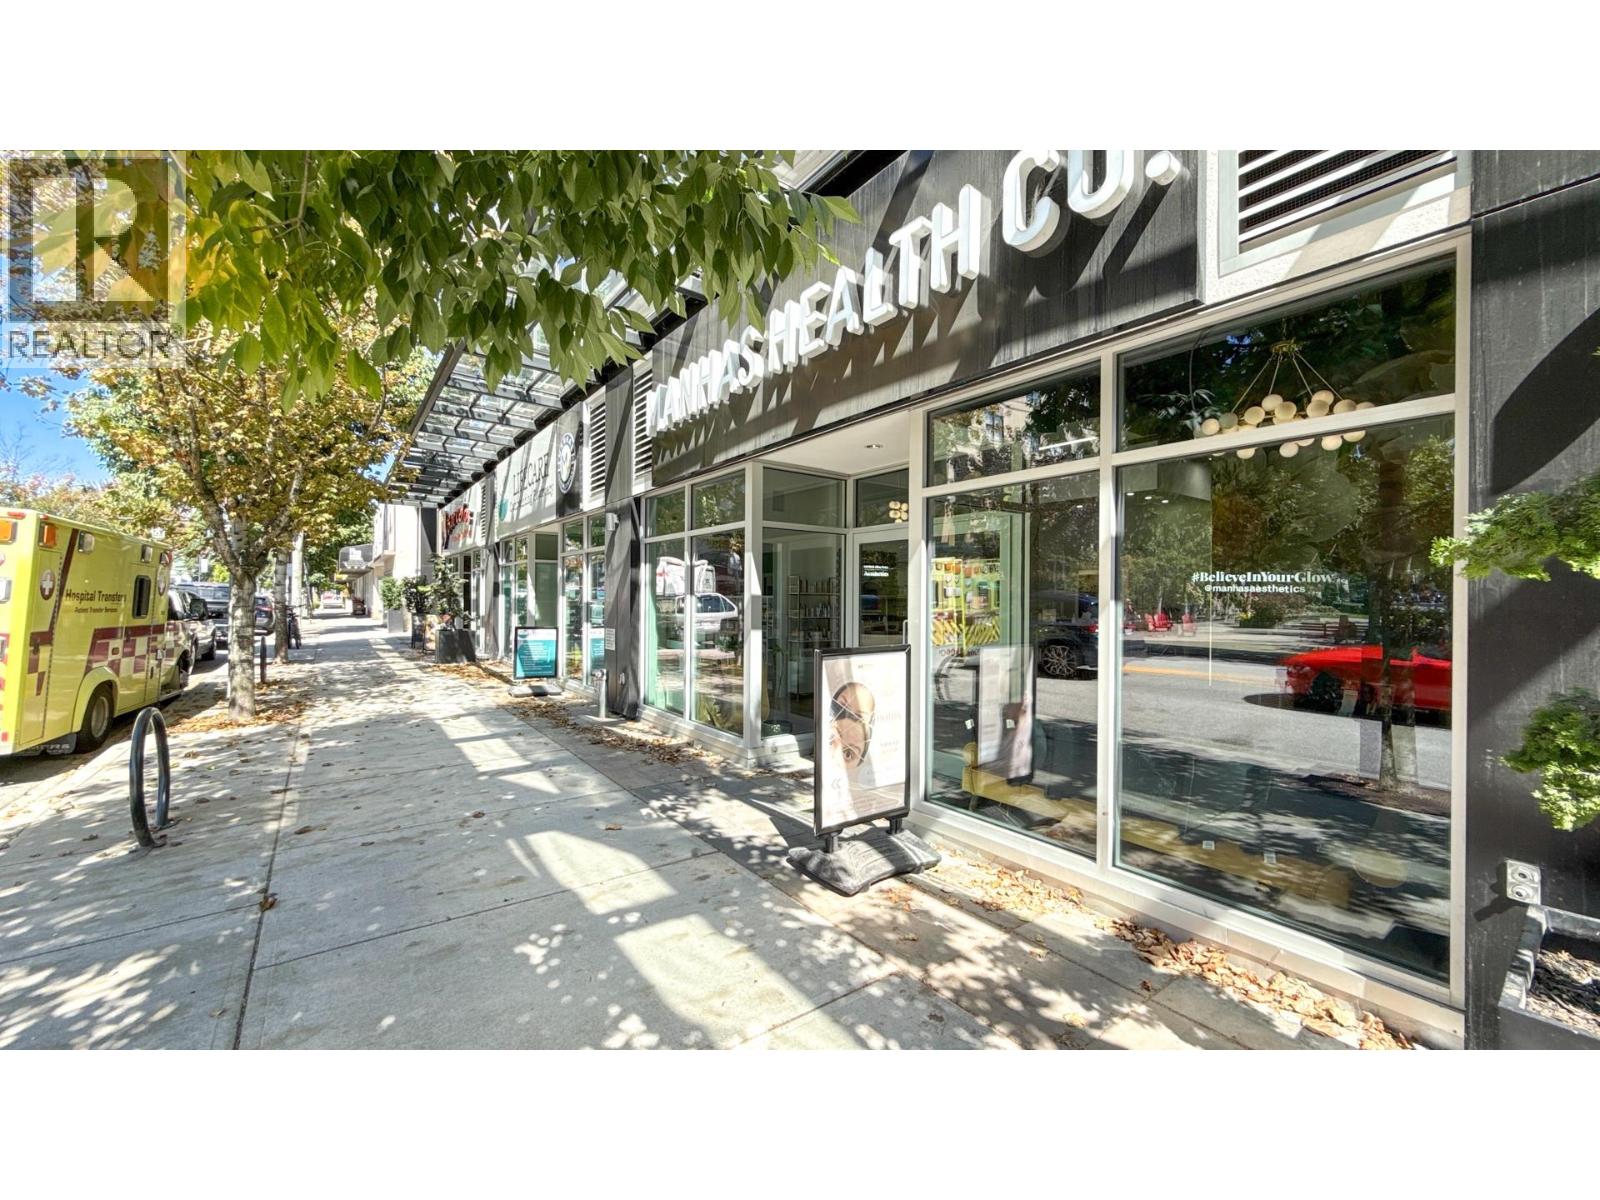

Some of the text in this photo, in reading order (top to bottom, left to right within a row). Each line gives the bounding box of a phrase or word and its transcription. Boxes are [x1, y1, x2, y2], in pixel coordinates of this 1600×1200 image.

[646, 150, 1181, 437] MANHAS HEALTH CO.
[1204, 584, 1306, 593] @manhasaesthetics
[65, 589, 96, 604] Hospital
